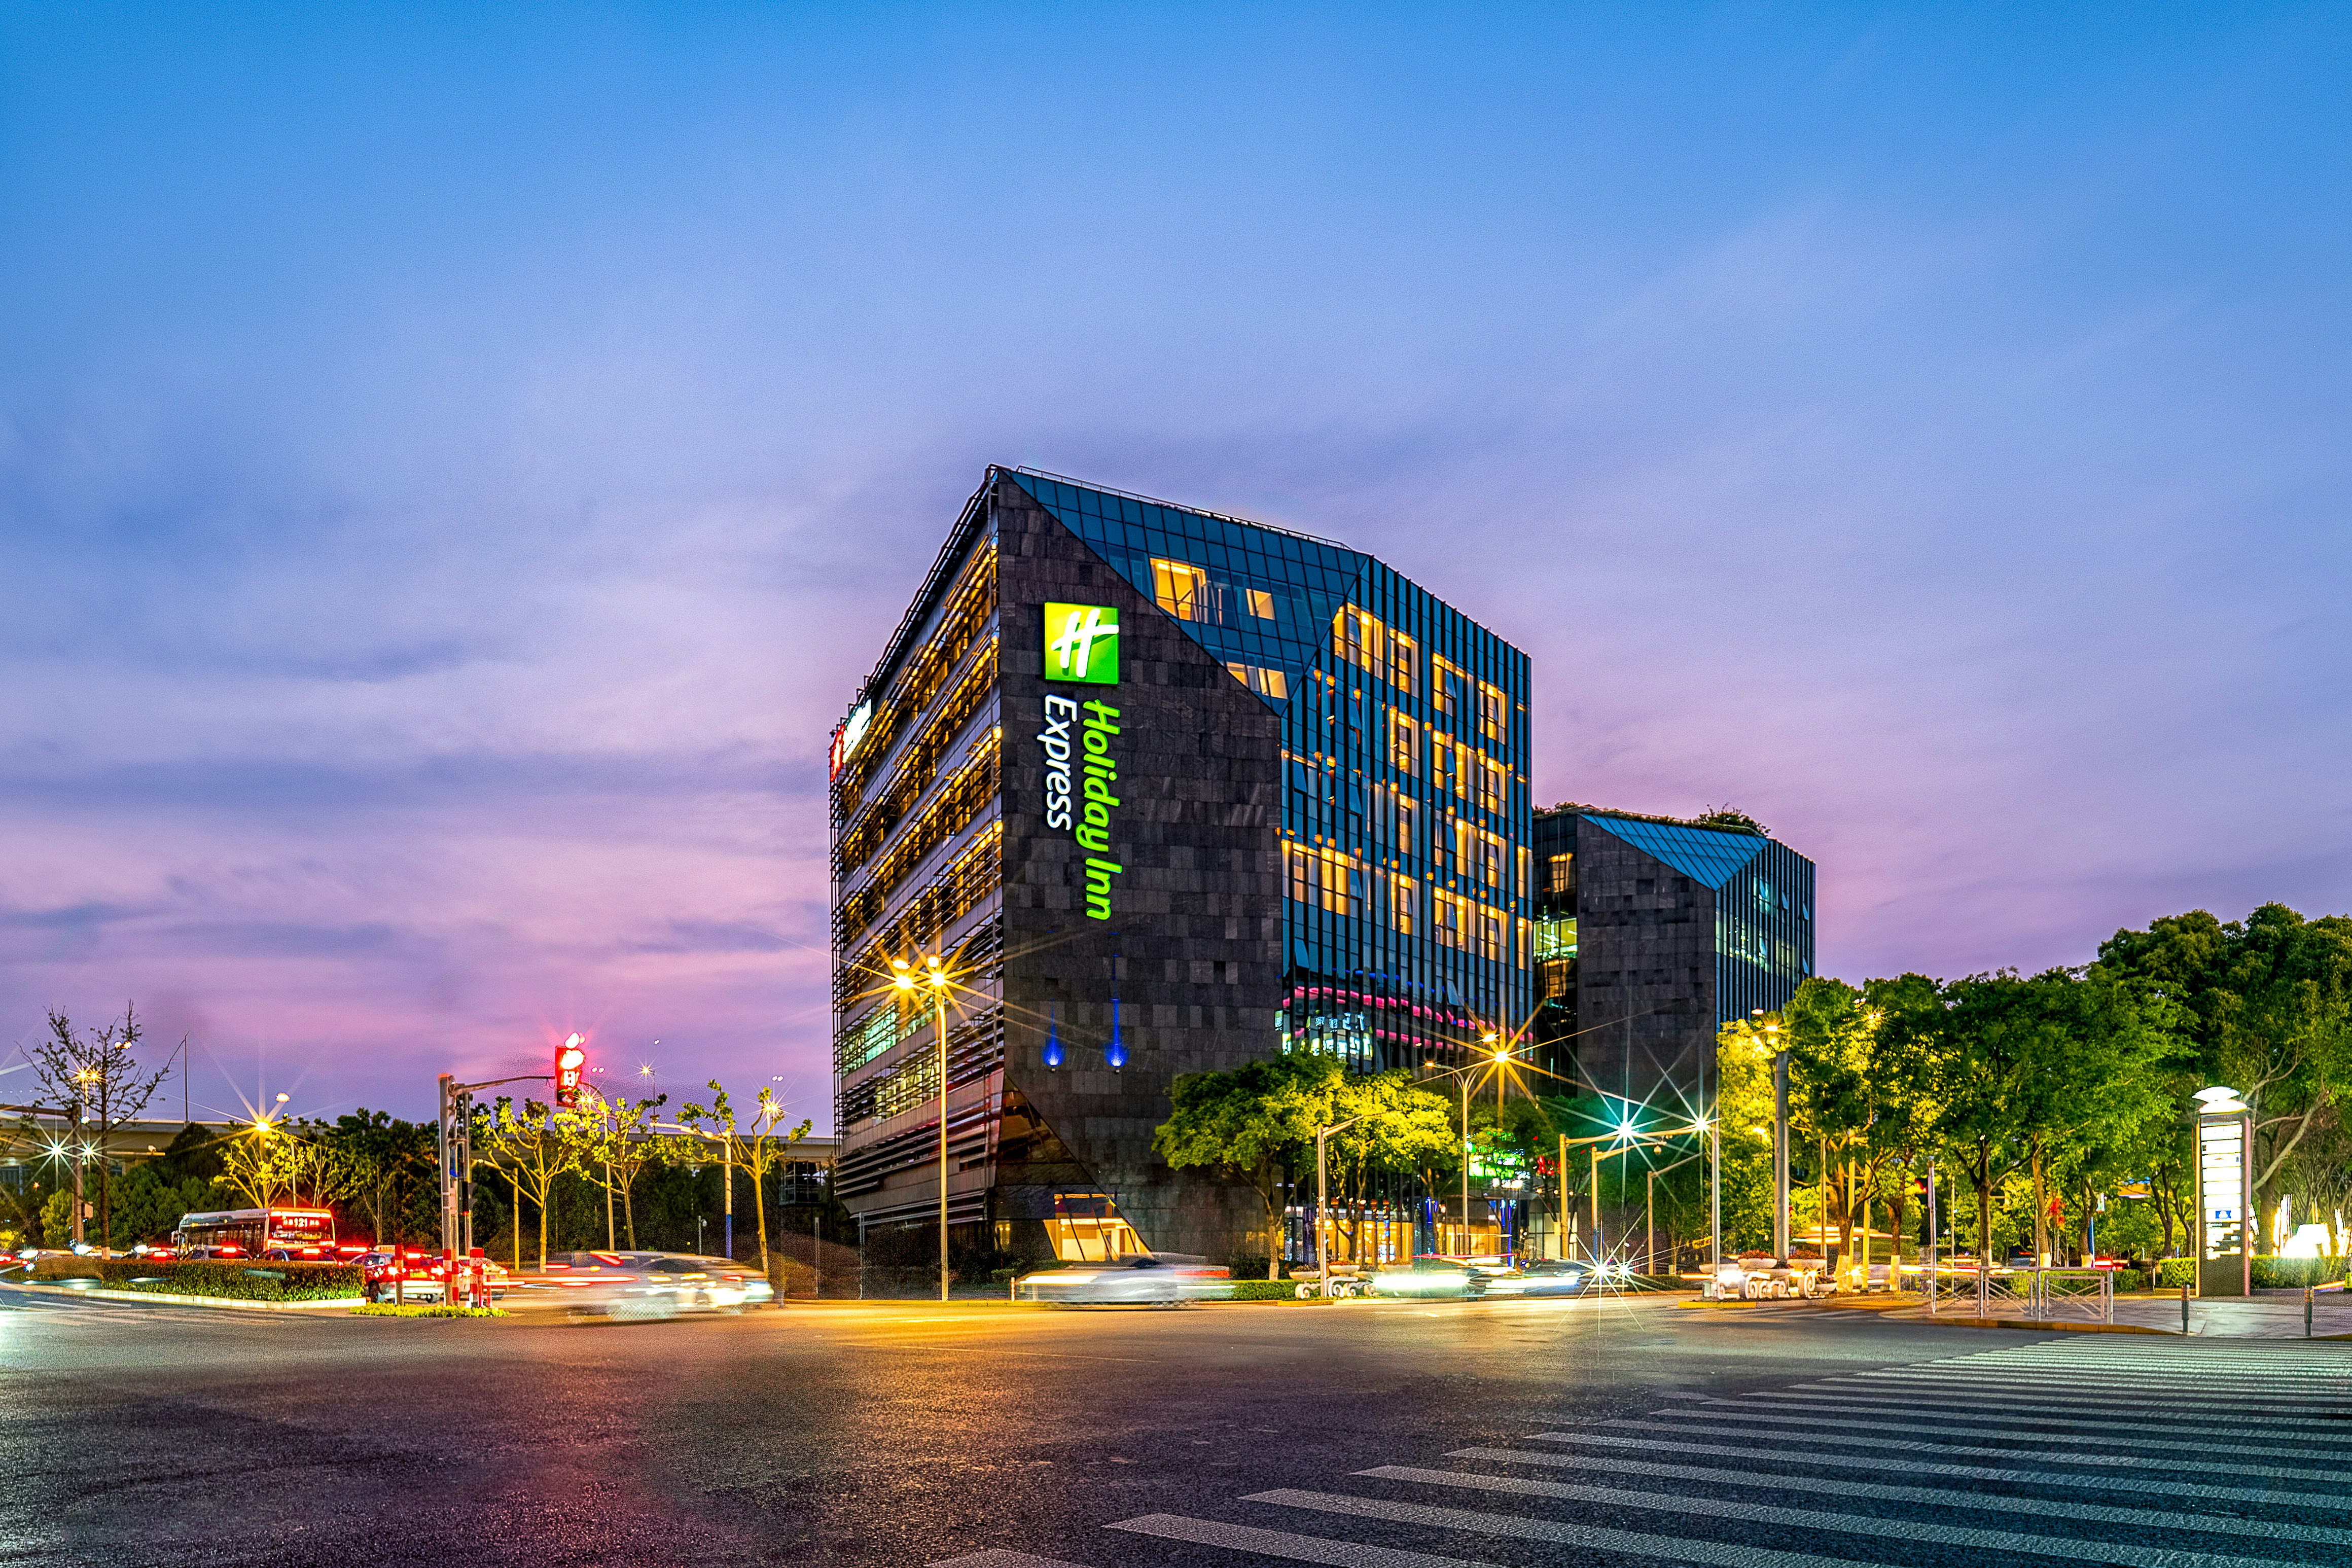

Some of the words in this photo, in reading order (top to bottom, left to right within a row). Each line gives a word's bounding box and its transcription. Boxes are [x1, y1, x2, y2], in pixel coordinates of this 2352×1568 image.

[1037, 694, 1078, 831] Express
[1076, 699, 1120, 852] Holiday
[1085, 857, 1122, 920] Inn
[294, 1218, 308, 1227] 121
